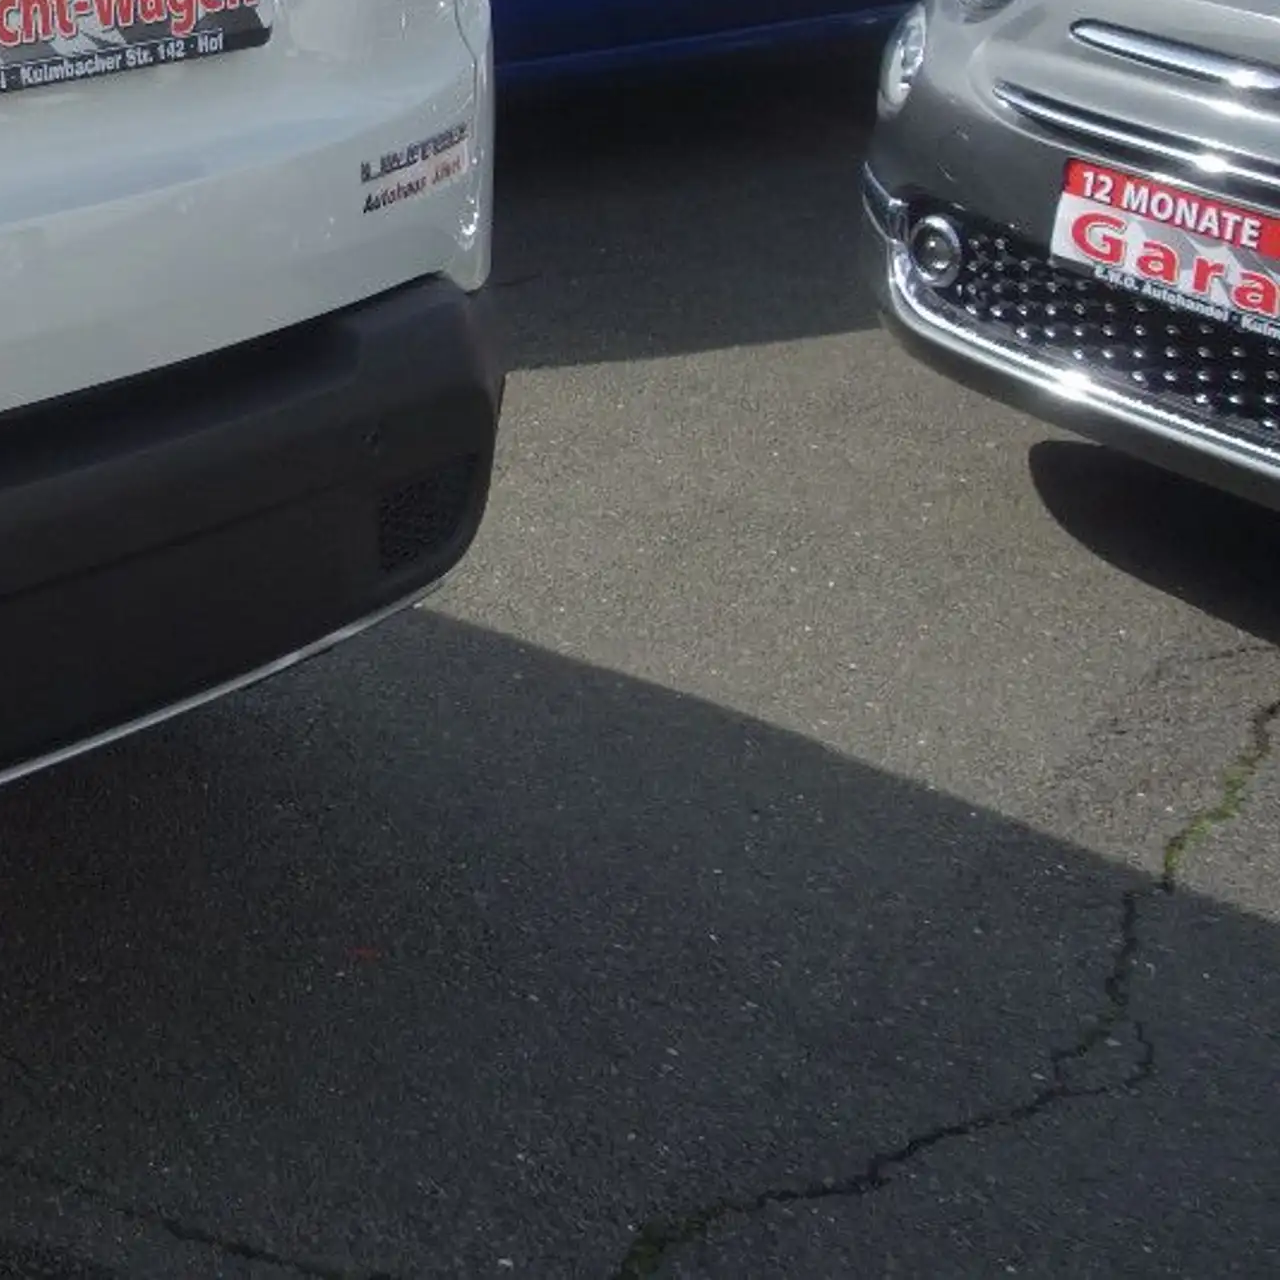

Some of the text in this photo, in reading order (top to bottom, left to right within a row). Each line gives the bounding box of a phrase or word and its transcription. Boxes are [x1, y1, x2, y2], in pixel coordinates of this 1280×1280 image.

[20, 53, 122, 87] Kulmbacher
[125, 47, 154, 66] Str.
[157, 39, 186, 60] 142
[196, 30, 225, 54] Hof
[1082, 171, 1261, 248] 12 MONATE
[1071, 212, 1280, 318] Gara
[1142, 281, 1229, 322] Autohandel
